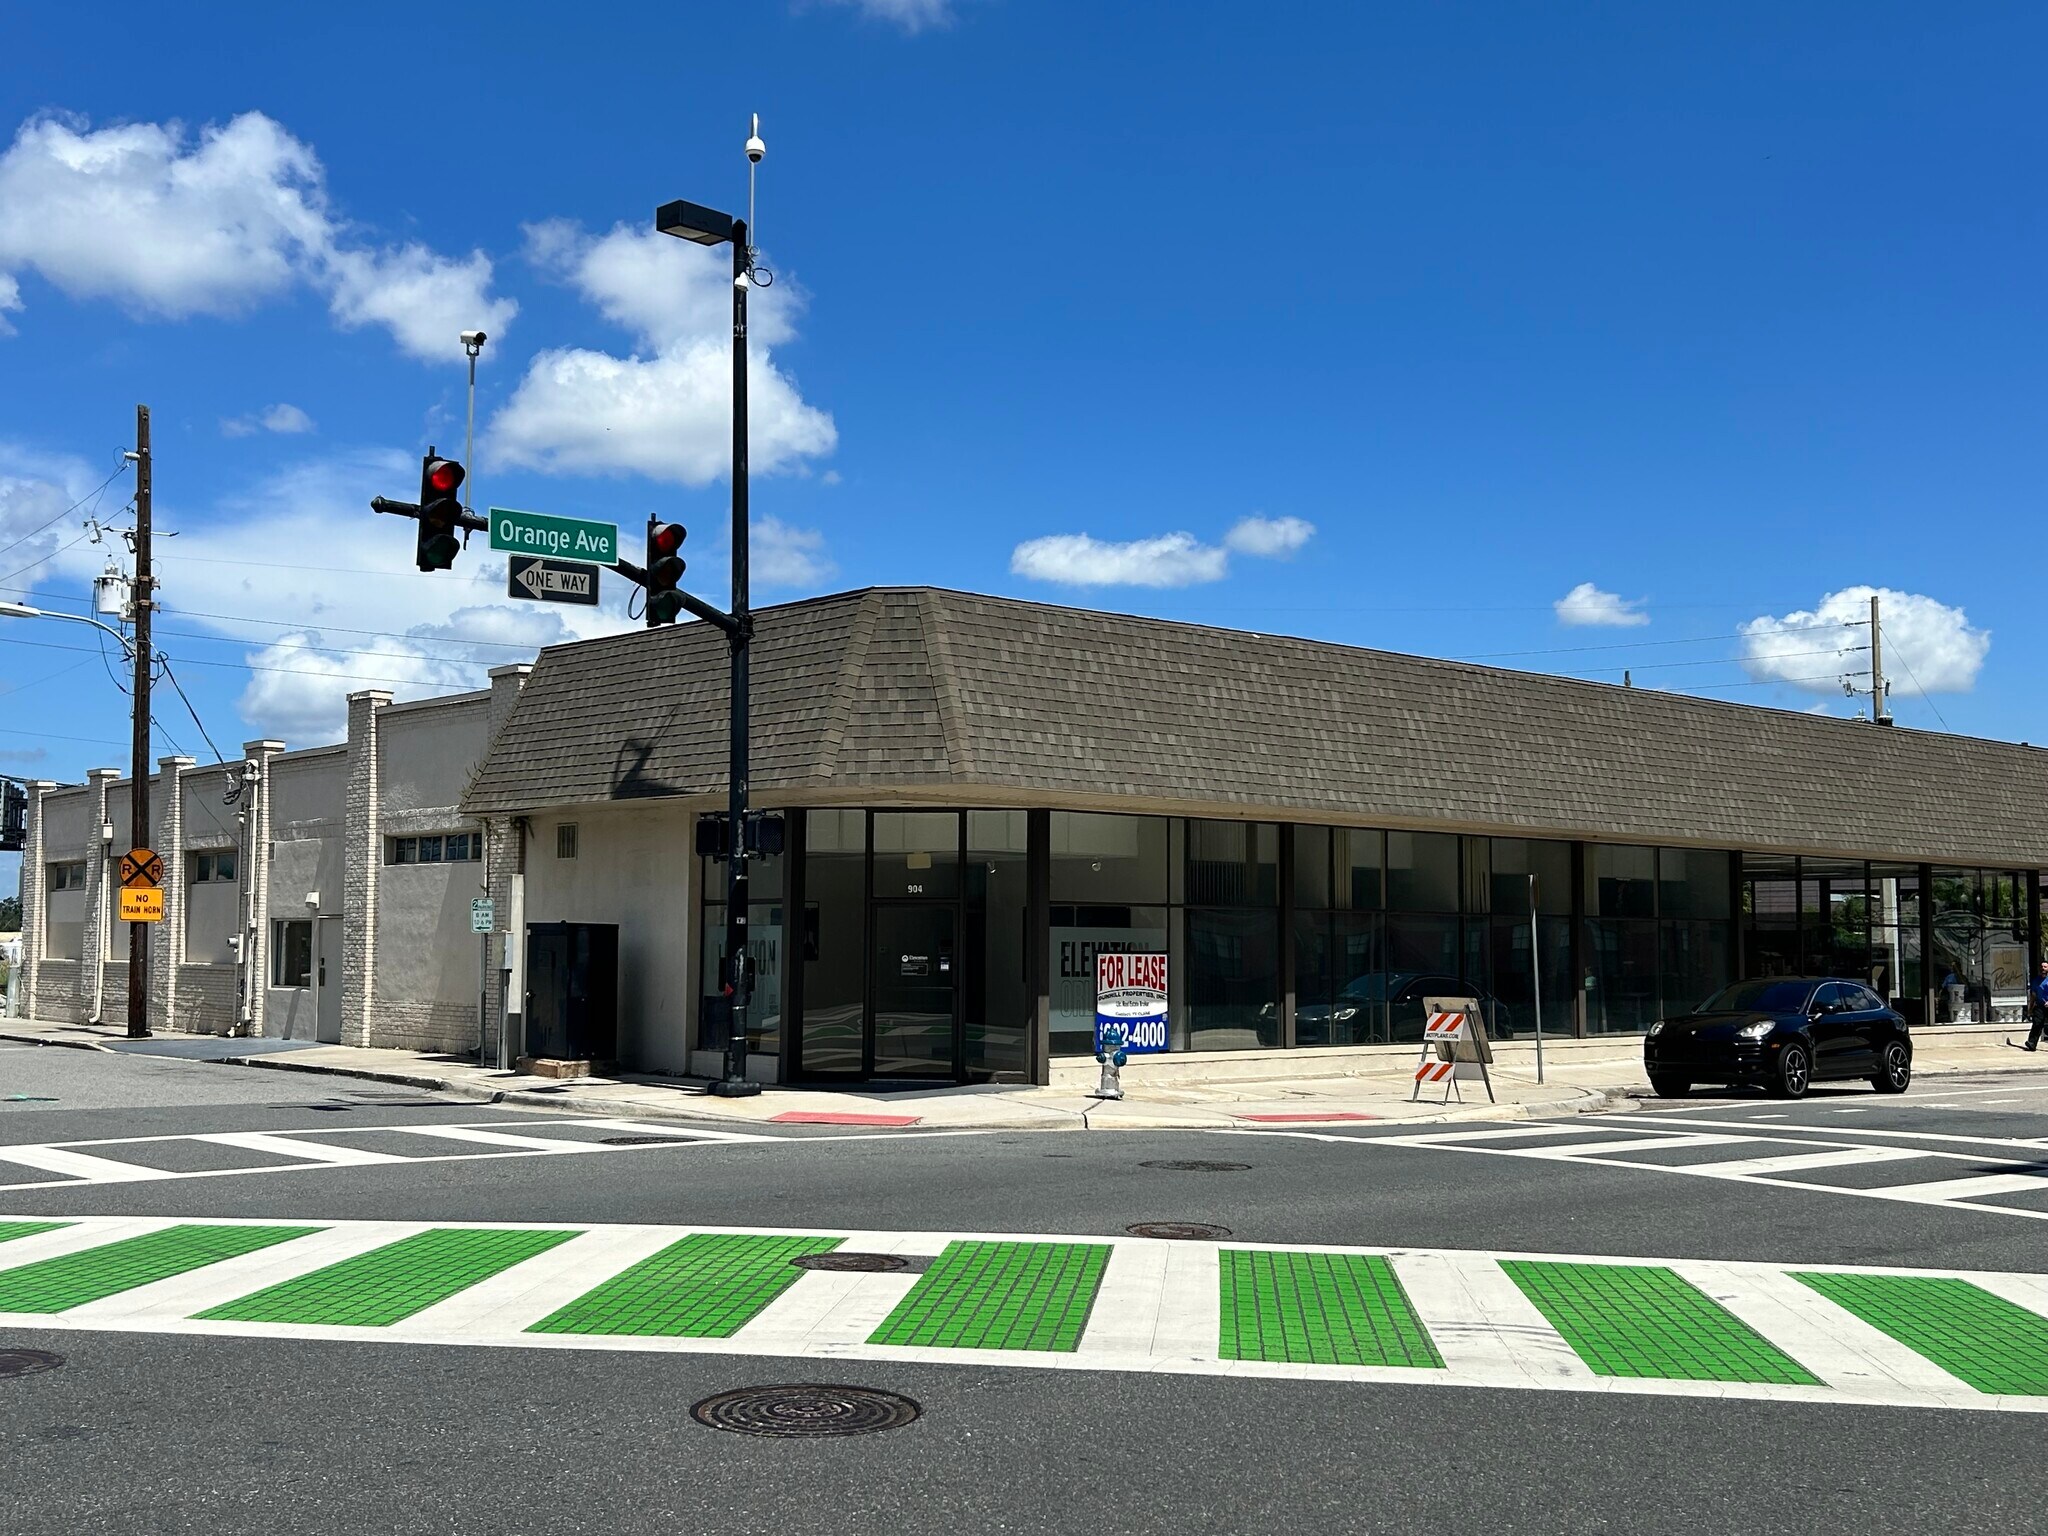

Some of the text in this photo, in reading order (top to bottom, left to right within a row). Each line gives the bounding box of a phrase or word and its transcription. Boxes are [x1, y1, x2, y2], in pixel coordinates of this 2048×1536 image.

[500, 519, 609, 554] Orange Ave
[526, 570, 587, 591] ONE WAY
[122, 864, 160, 875] R R
[907, 884, 923, 894] 904
[1099, 955, 1124, 991] FOR
[1127, 955, 1166, 991] LEASE
